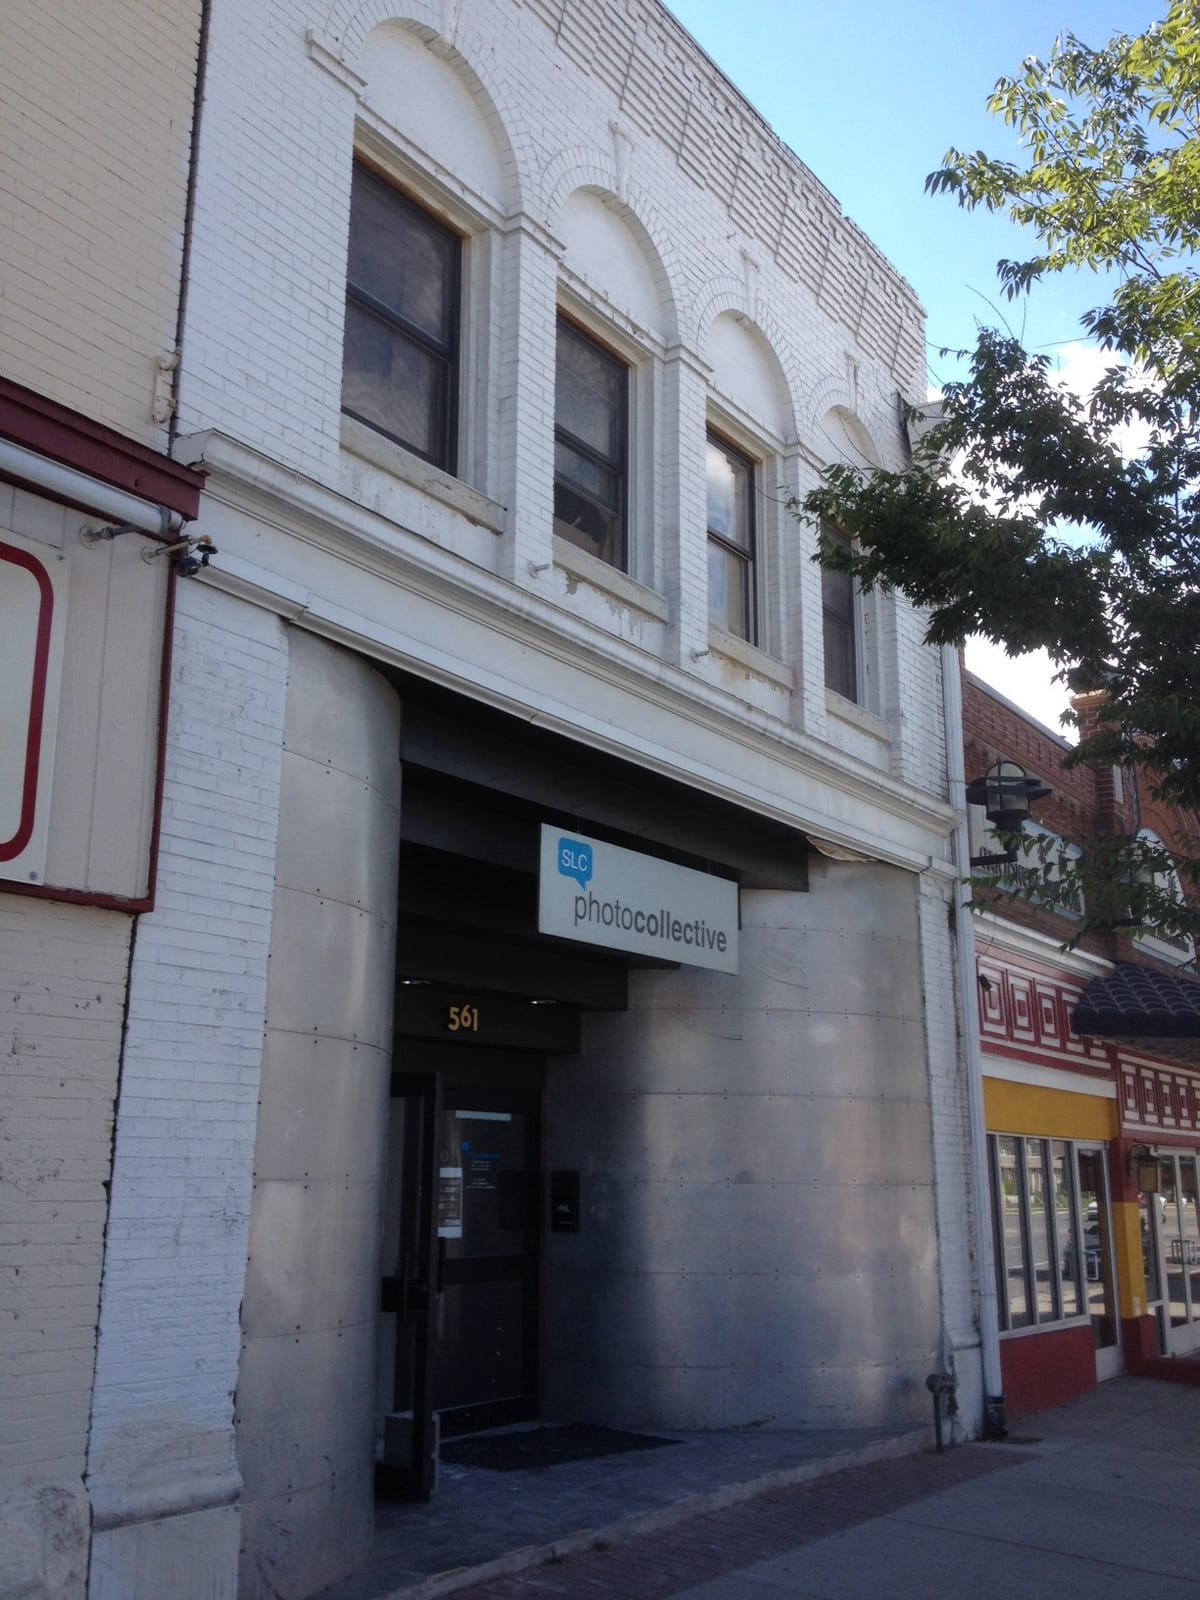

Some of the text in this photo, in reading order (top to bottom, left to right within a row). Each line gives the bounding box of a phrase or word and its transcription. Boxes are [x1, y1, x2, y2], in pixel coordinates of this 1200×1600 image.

[561, 850, 588, 872] SLC
[574, 891, 727, 952] photocollective
[448, 1005, 479, 1031] 561
